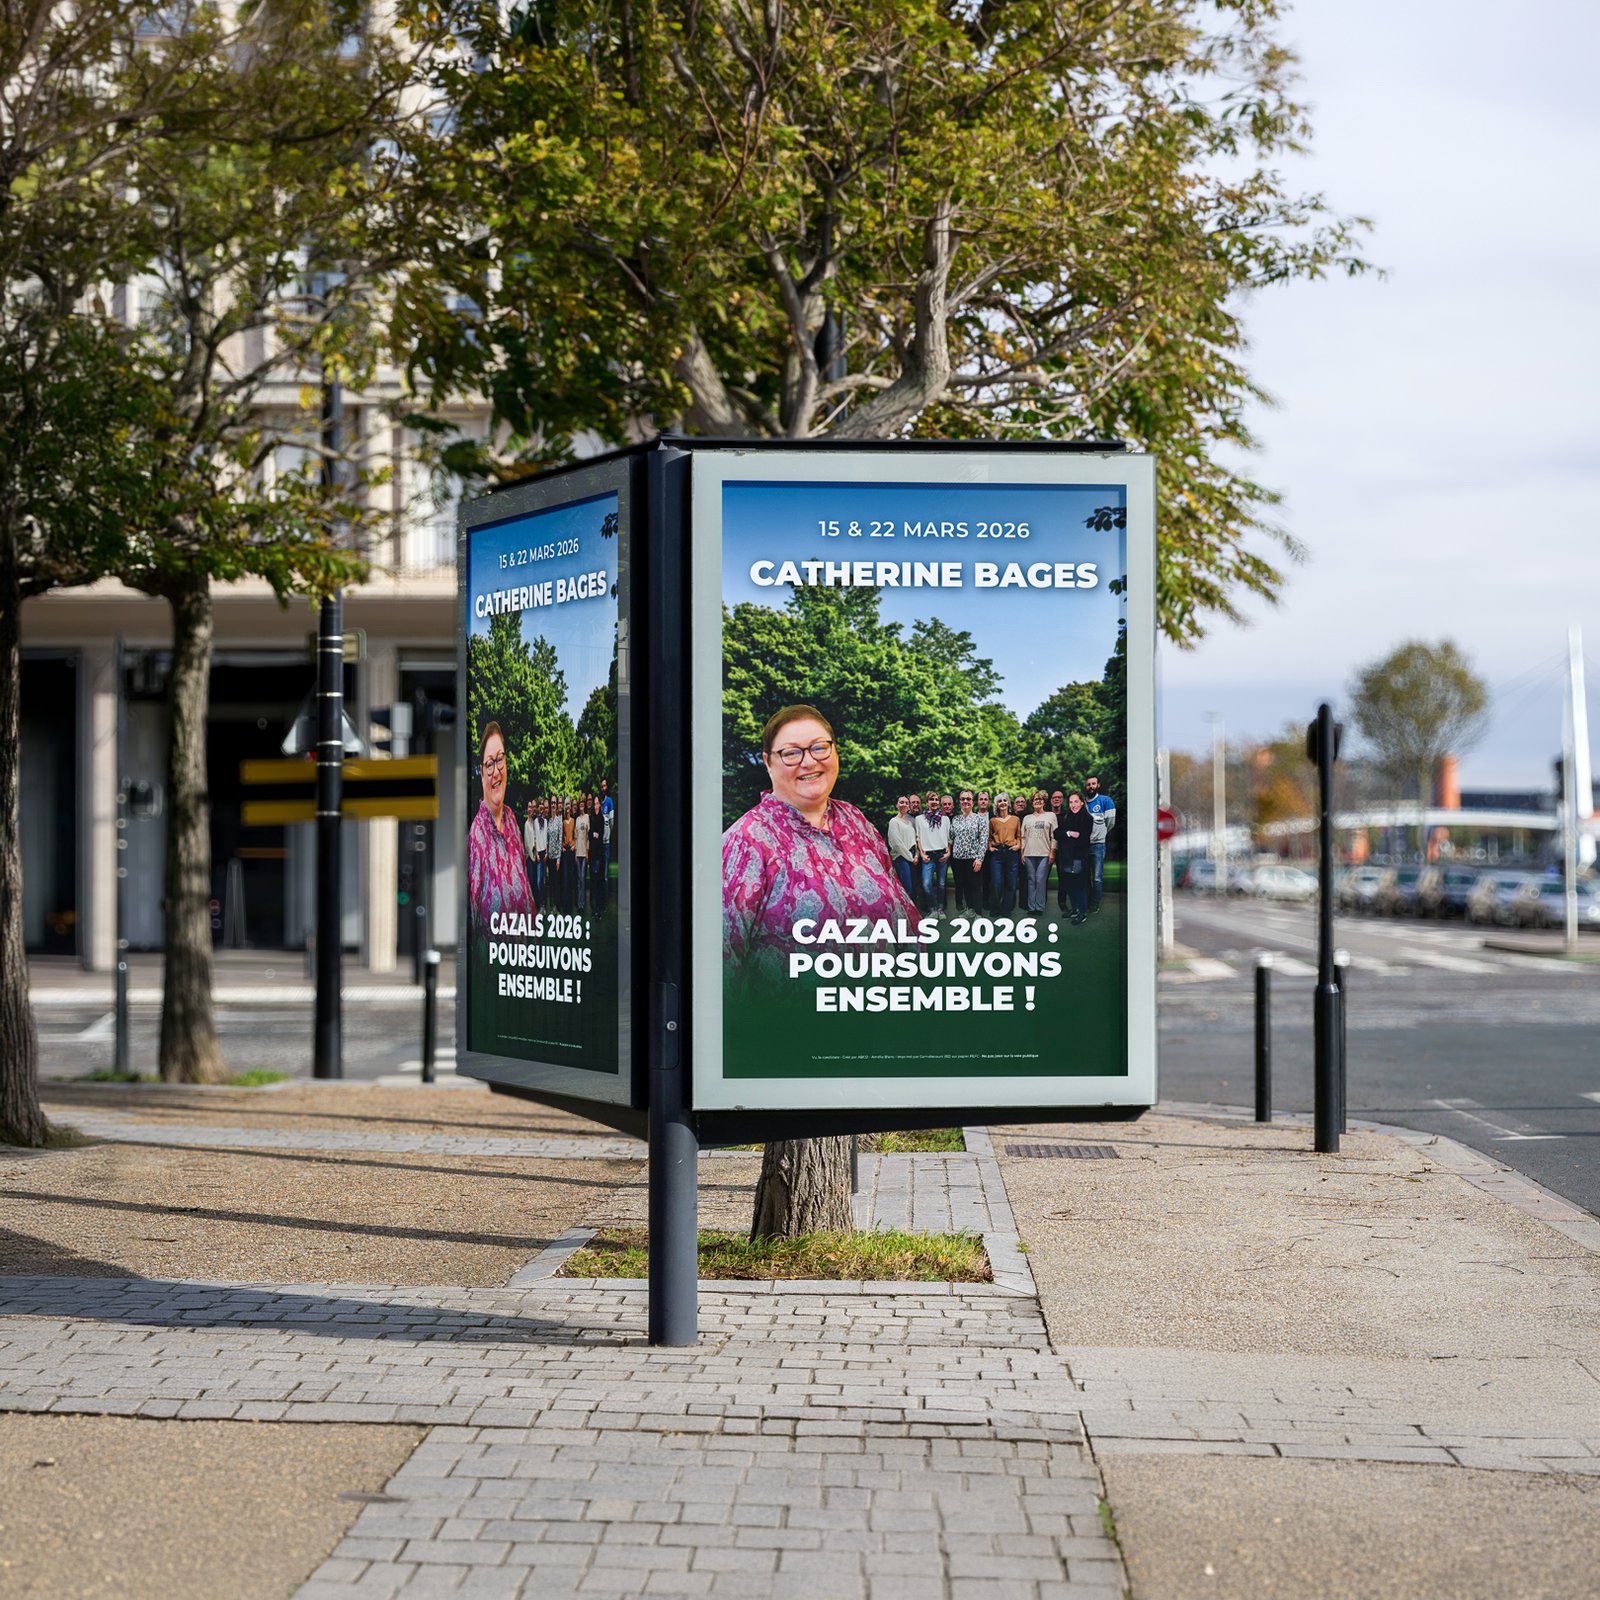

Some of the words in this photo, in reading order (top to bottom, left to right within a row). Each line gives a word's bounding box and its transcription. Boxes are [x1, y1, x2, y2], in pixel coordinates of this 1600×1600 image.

[819, 522, 839, 536] 15
[870, 522, 895, 537] 22
[904, 522, 969, 538] MARS
[976, 523, 1030, 538] 2026
[499, 554, 508, 569] 15
[517, 550, 527, 565] 22
[530, 544, 555, 562] MARS
[557, 538, 579, 557] 2026
[750, 561, 962, 587] CATHERINE
[975, 562, 1098, 588] BAGES
[475, 581, 553, 618] CATHERINE
[556, 570, 607, 604] BAGES
[490, 911, 544, 938] CAZALS
[547, 914, 582, 940] 2026
[792, 918, 939, 944] CAZALS
[950, 918, 1037, 944] 2026
[489, 942, 592, 973] POURSUIVONS
[789, 952, 1062, 978] POURSUIVONS
[498, 973, 573, 1003] ENSEMBLE
[816, 986, 1013, 1012] ENSEMBLE
